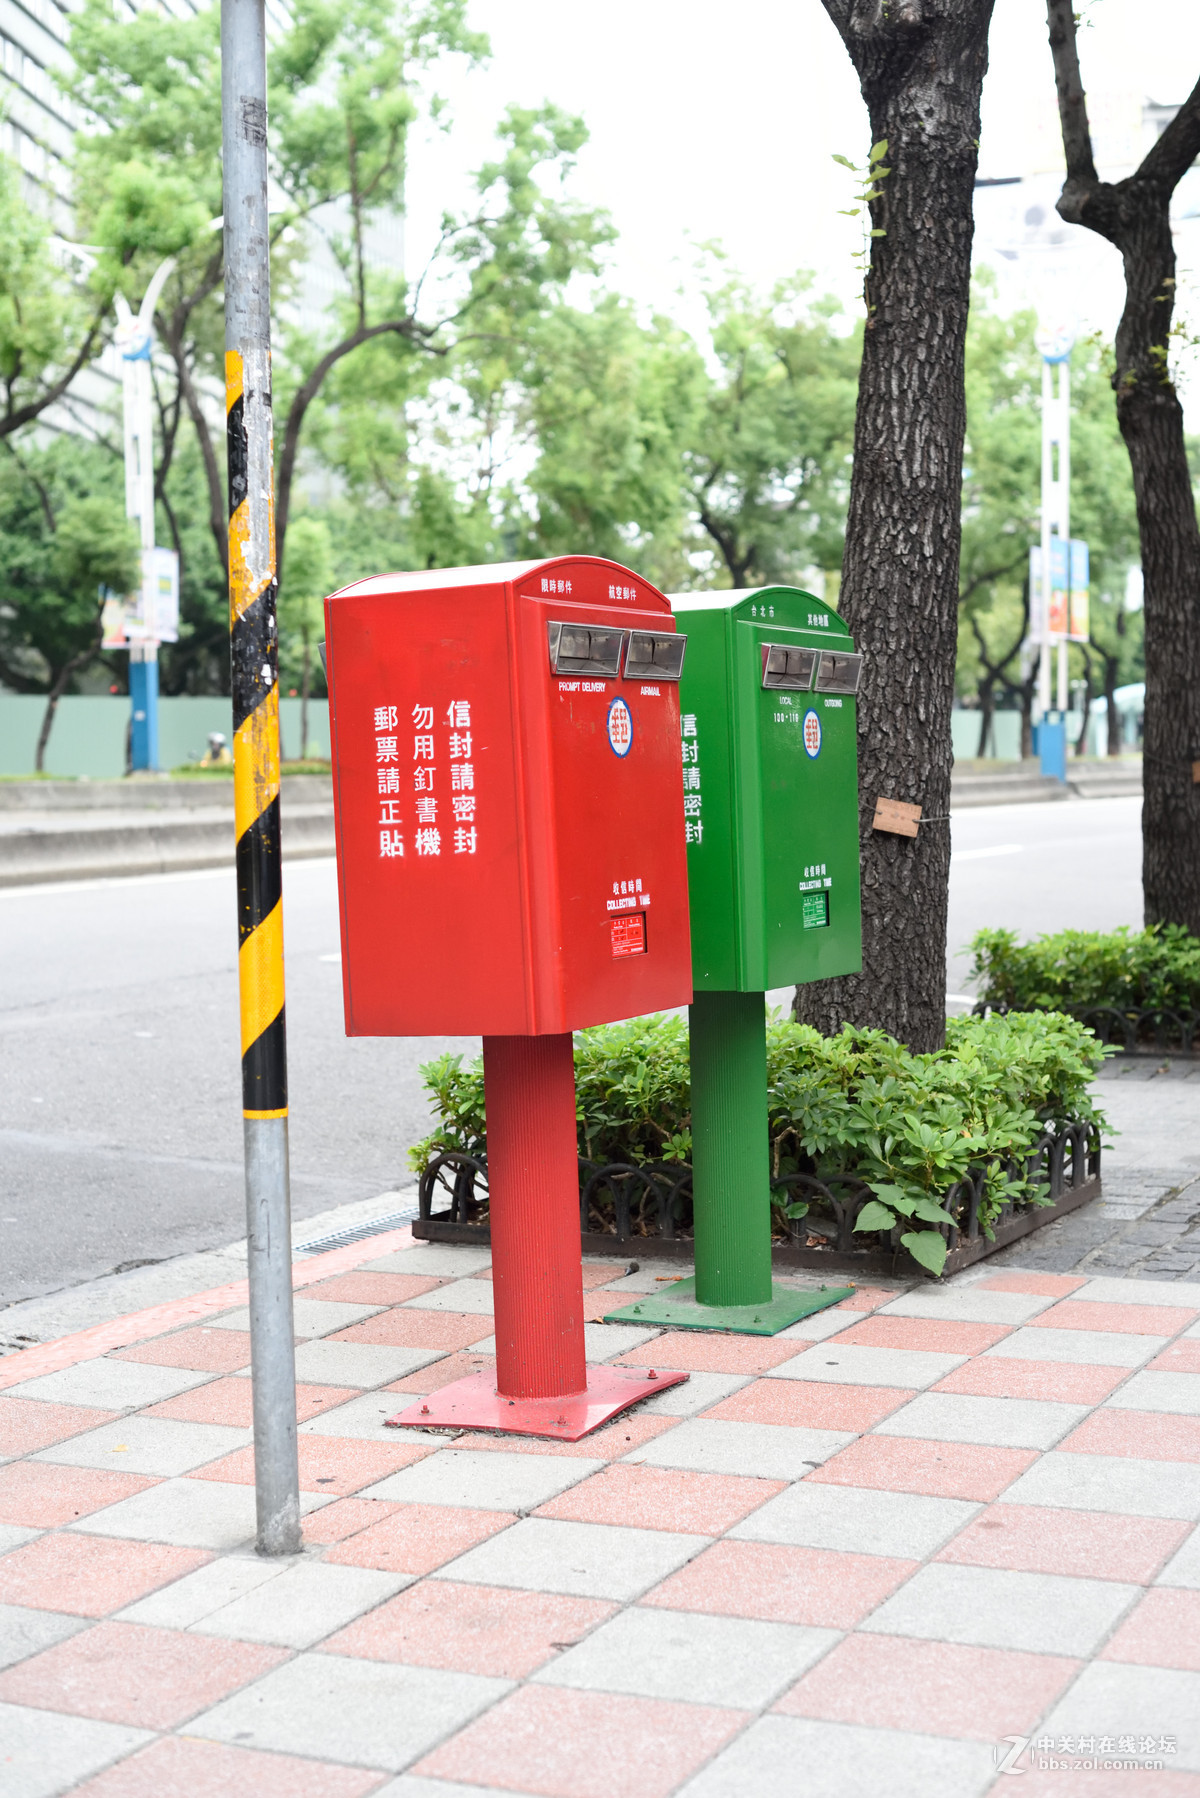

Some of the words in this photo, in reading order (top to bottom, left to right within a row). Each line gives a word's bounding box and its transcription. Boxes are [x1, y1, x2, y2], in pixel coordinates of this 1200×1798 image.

[541, 578, 572, 594] 限時郵件
[608, 585, 636, 600] 航空郵件
[751, 604, 774, 618] 台北市
[559, 681, 580, 692] PROMPT
[582, 682, 605, 693] DELIVERY
[640, 686, 661, 696] AIRMAIL
[779, 696, 792, 705] LOCAL
[373, 705, 404, 858] 郵票請正貼
[411, 703, 441, 856] 勿用釘書機
[447, 700, 478, 855] 信封請密封
[612, 878, 643, 895] 收信時間
[606, 896, 636, 911] COLLECTING
[639, 894, 650, 906] TIME
